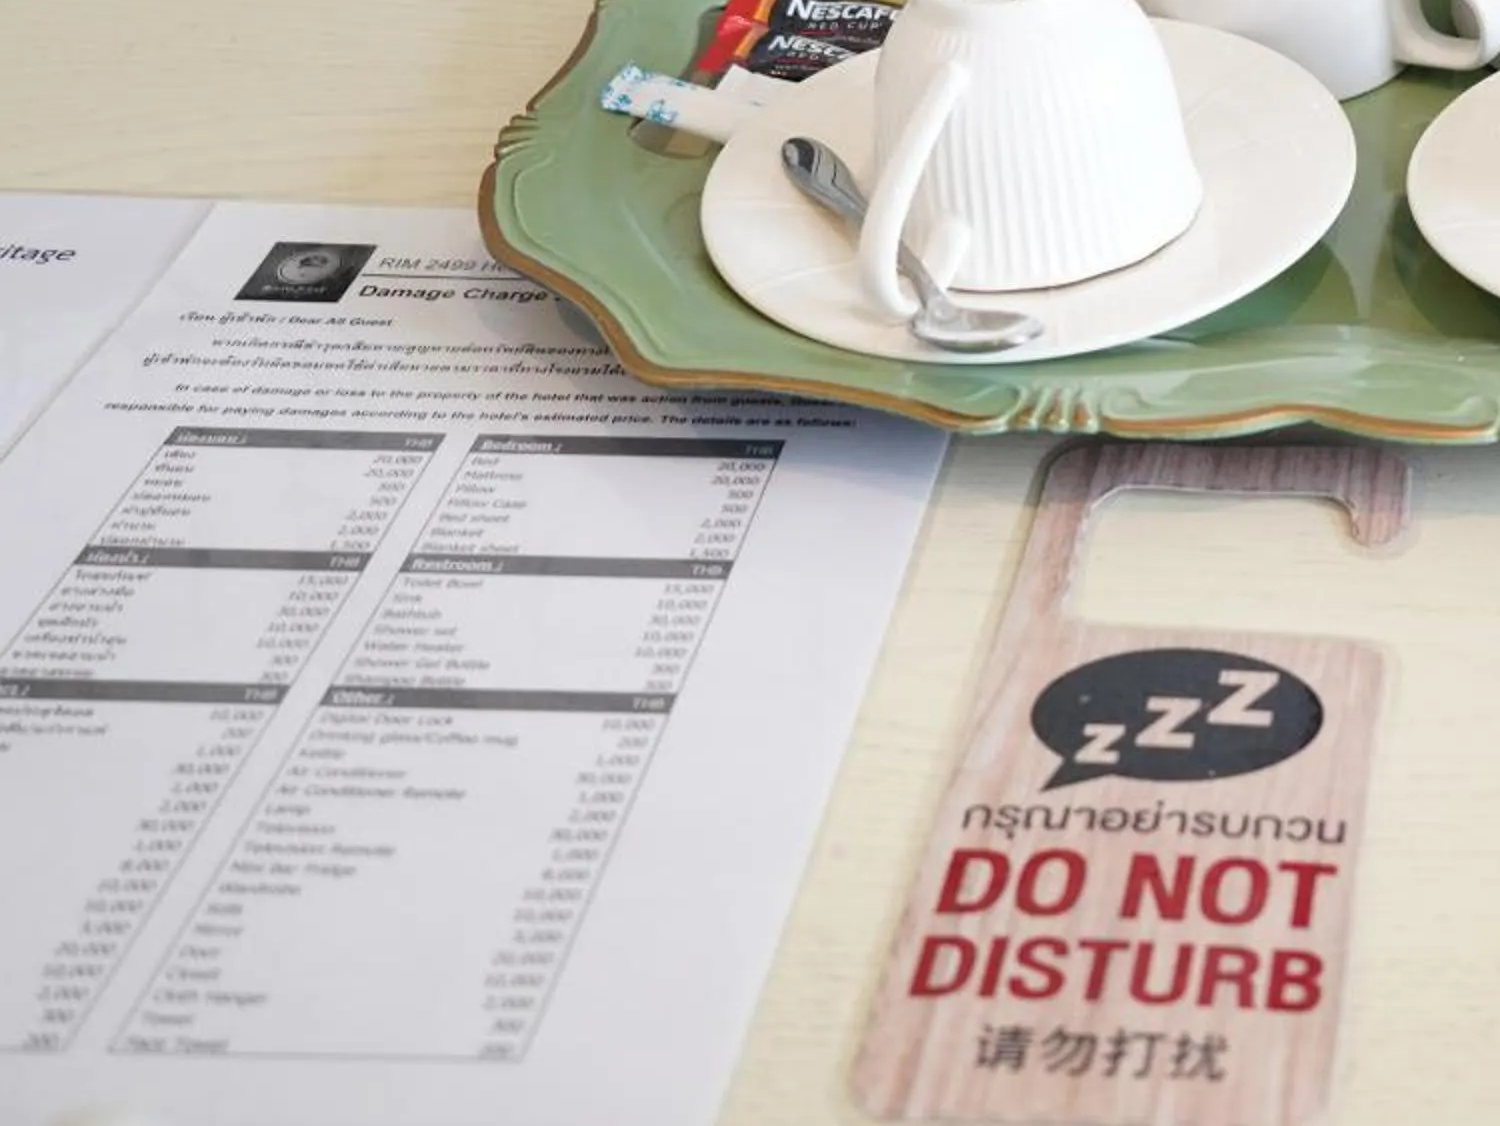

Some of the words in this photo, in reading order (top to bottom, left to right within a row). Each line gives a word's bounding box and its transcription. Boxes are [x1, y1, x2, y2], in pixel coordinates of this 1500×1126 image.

[0, 244, 77, 265] itage
[379, 257, 422, 271] RIM
[425, 258, 478, 272] 2499
[358, 285, 456, 302] Damage
[462, 287, 548, 304] Charge
[251, 385, 311, 398] damage
[371, 388, 385, 397] to
[389, 389, 413, 398] the
[416, 391, 479, 402] property
[485, 391, 500, 401] of
[504, 391, 528, 401] the
[532, 392, 571, 402] hotel
[574, 393, 603, 403] that
[607, 396, 636, 404] was
[222, 406, 275, 417] paying
[279, 407, 347, 418] damages
[351, 409, 427, 420] according
[431, 410, 447, 419] to
[451, 410, 477, 420] the
[534, 412, 608, 422] estimated
[660, 415, 687, 424] The
[691, 415, 742, 425] details
[481, 440, 551, 451] Bedroom
[717, 461, 765, 472] 20,000
[411, 558, 492, 571] Restroom
[961, 801, 1347, 844] กรุณาอย่ารบกวน
[934, 847, 1088, 917] DO
[1118, 853, 1338, 929] NOT
[908, 935, 1324, 1013] DISTURB
[974, 1024, 1230, 1083] 请勿打扰
